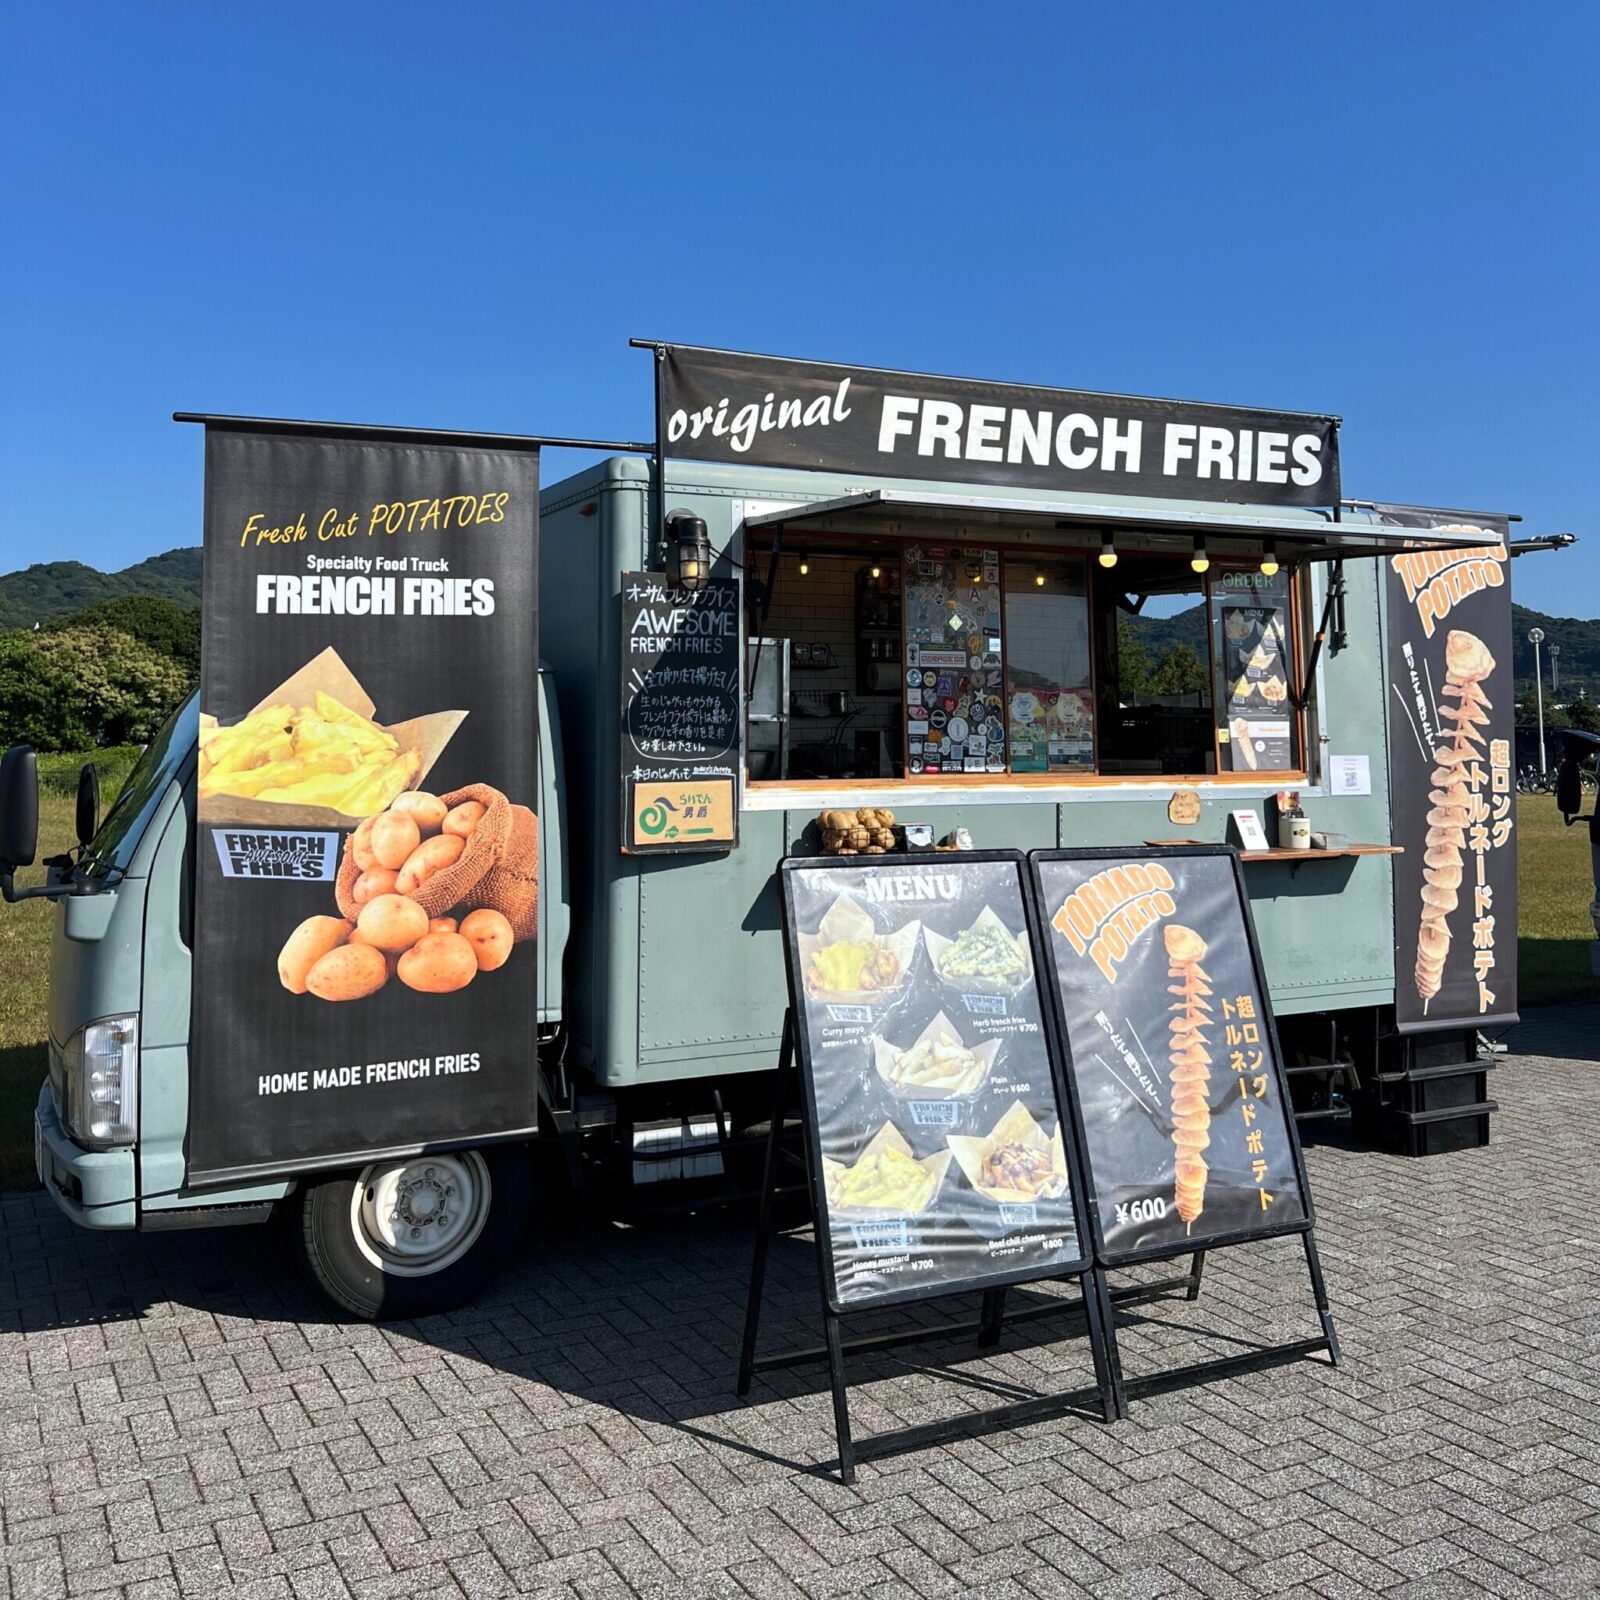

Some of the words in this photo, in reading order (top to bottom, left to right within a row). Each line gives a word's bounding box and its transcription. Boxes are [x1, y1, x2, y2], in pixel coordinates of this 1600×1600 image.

[667, 377, 852, 453] original
[877, 393, 1141, 474] FRENCH
[1163, 422, 1323, 487] FRIES
[239, 512, 308, 548] Fresh
[317, 508, 360, 541] Cut
[367, 491, 510, 536] POTATOES
[306, 554, 372, 574] Specialty
[375, 556, 408, 572] Food
[410, 557, 449, 573] Truck
[1222, 571, 1275, 589] ORDER
[256, 574, 396, 615] FRENCH
[403, 577, 496, 617] FRIES
[1416, 558, 1505, 639] POTATO
[631, 608, 738, 637] AWESOME
[630, 637, 681, 654] FRENCH
[684, 637, 723, 654] FRIES
[632, 764, 691, 781] 本日のじゃがいも
[680, 793, 712, 805] らいでん
[1489, 739, 1513, 848] 超ロング
[224, 833, 326, 855] FRENCH
[230, 857, 324, 878] FRIES
[244, 849, 311, 864] AWESOME
[864, 874, 960, 902] MENU
[1469, 761, 1496, 1014] トルネードポテト
[1051, 862, 1175, 957] TORNADO
[1089, 891, 1177, 985] POTATO
[822, 1028, 843, 1037] Curry
[844, 1025, 865, 1035] mayo
[1019, 1023, 1038, 1032] ¥700
[1235, 995, 1270, 1099] 超ロング
[258, 1072, 308, 1096] HOME
[313, 1066, 362, 1089] MADE
[366, 1058, 431, 1084] FRENCH
[435, 1053, 481, 1076] FRIES
[990, 1075, 1008, 1085] Plain
[1010, 1083, 1030, 1093] ¥600
[1220, 997, 1274, 1212] トルネードポテト
[1114, 1196, 1167, 1225] ¥600
[1021, 1233, 1046, 1243] cheese
[878, 1253, 910, 1266] mustard
[911, 1259, 934, 1271] ¥700
